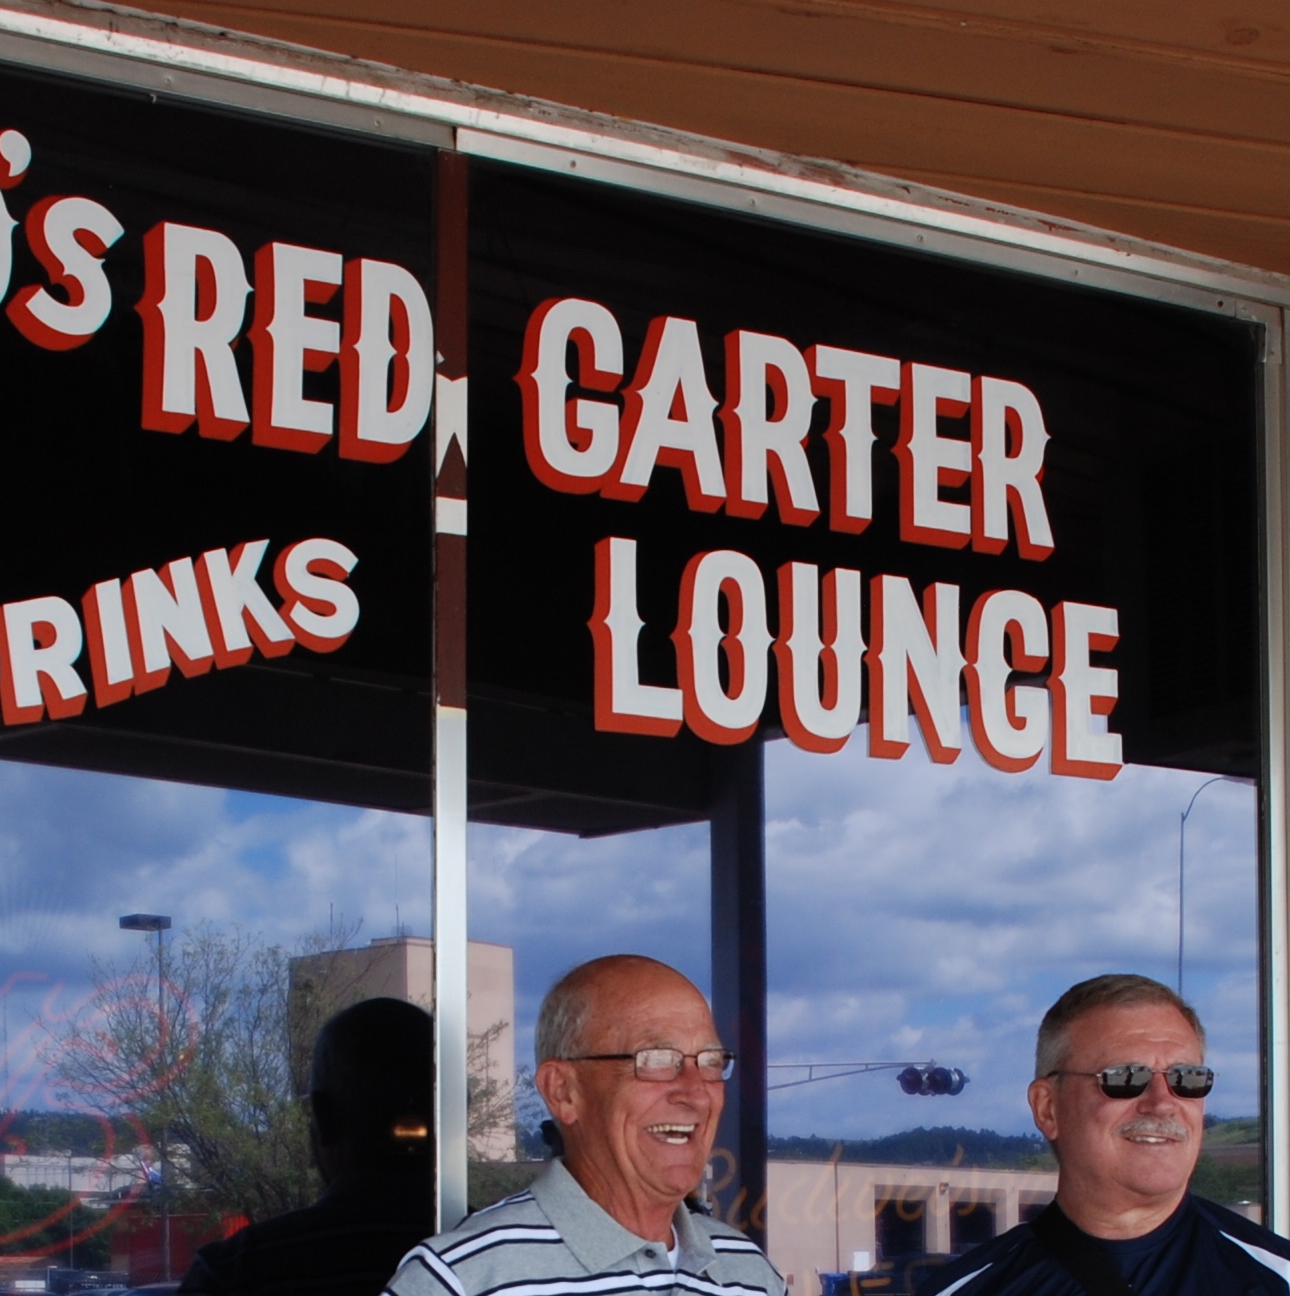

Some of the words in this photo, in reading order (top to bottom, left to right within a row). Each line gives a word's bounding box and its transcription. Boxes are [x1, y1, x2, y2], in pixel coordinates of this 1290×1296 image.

[133, 220, 434, 464] RED
[513, 296, 1055, 561] GARTER
[586, 536, 1124, 780] LOUNGE
